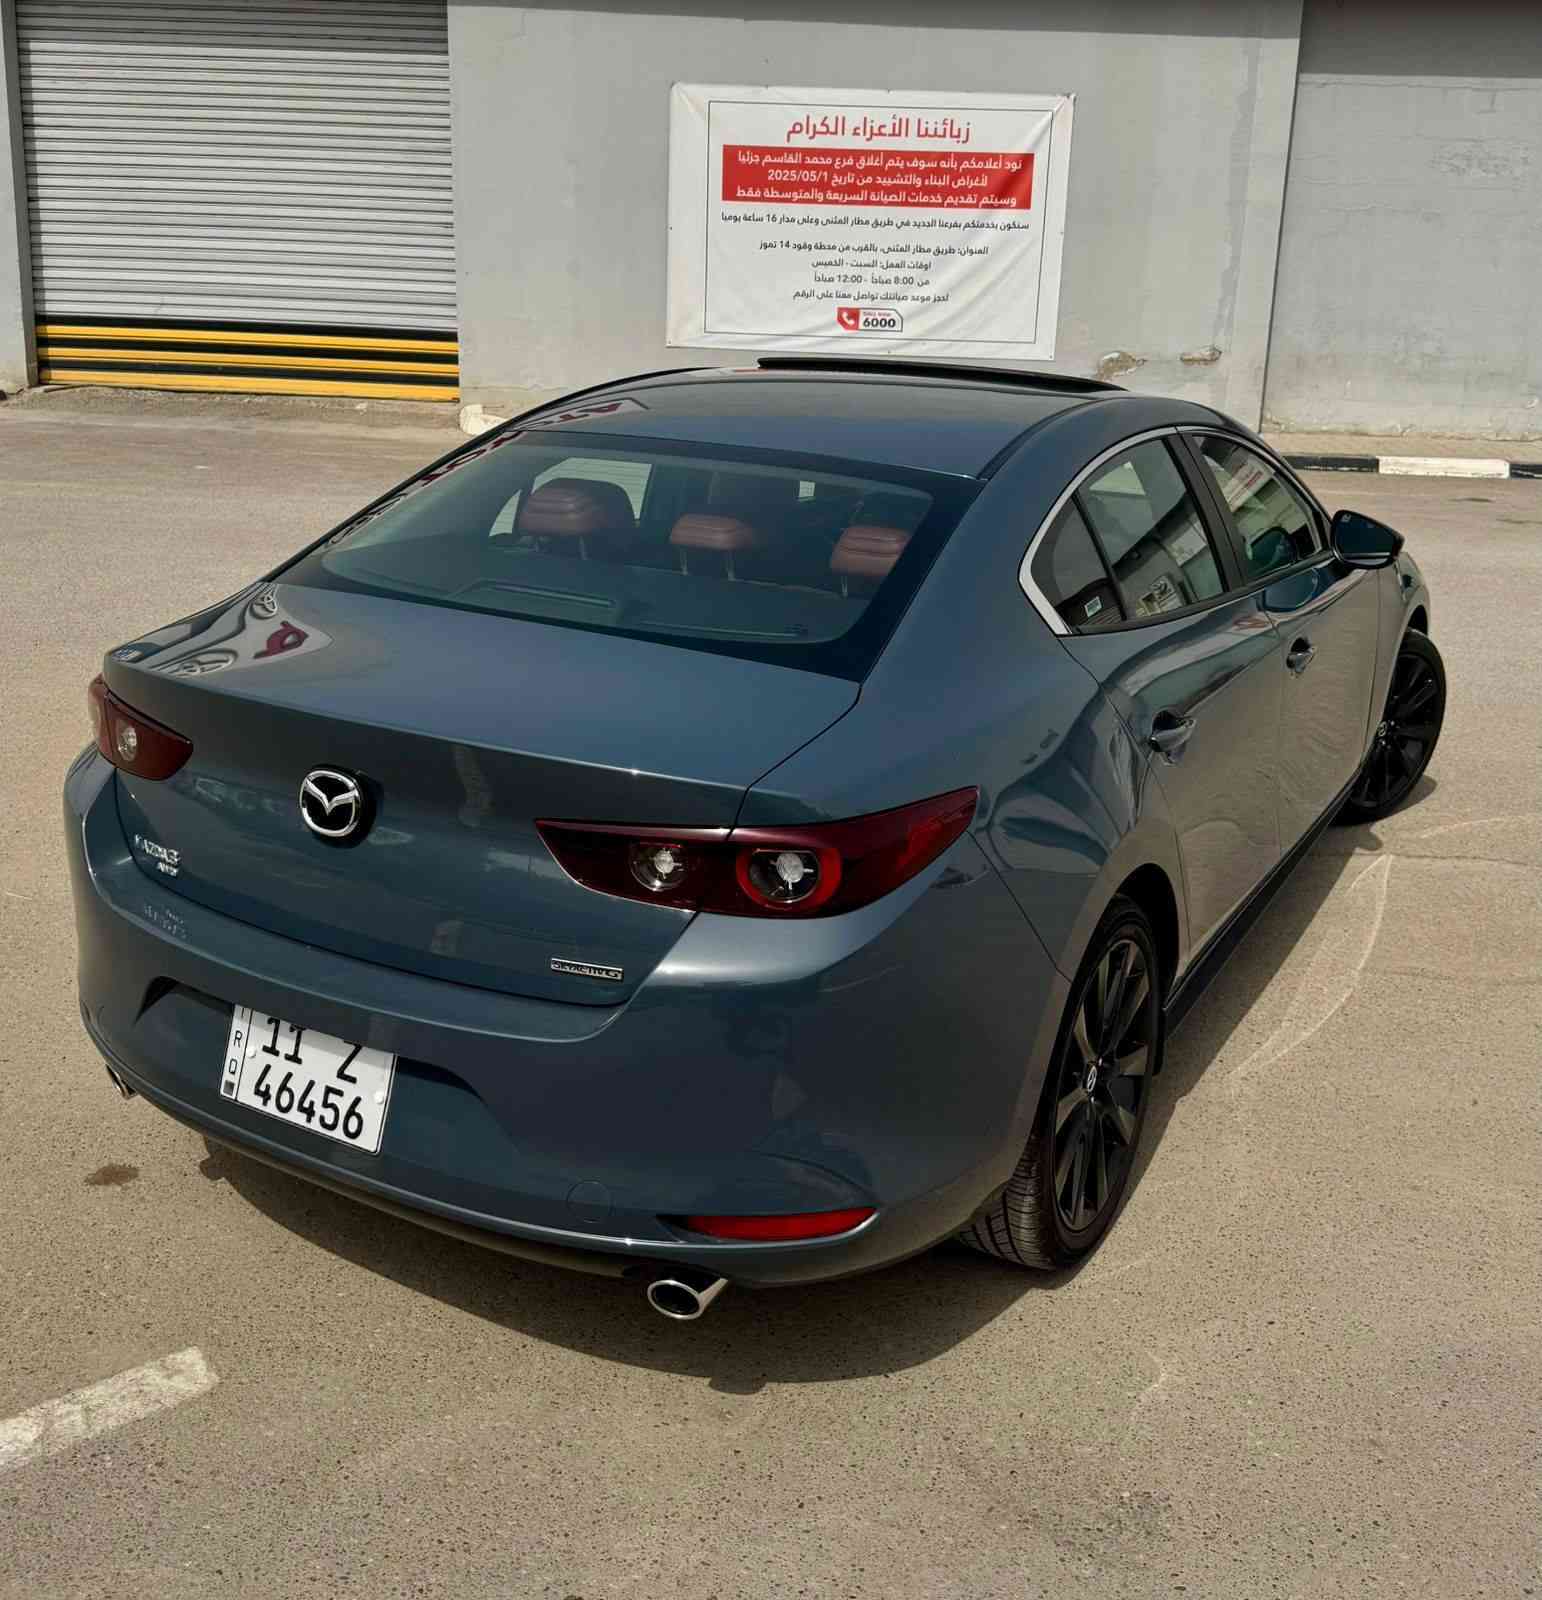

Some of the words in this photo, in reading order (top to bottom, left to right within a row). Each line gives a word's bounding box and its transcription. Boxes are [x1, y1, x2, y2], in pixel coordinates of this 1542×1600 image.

[786, 114, 845, 144] الكرام
[852, 114, 909, 142] الأعزاء
[917, 117, 970, 144] زبائننا
[762, 152, 801, 167] القاسم
[804, 155, 832, 165] محمد
[834, 156, 854, 169] فرع
[885, 156, 904, 170] يتم
[907, 158, 938, 170] سوف
[1004, 160, 1022, 172] نود
[768, 169, 828, 182] 2025/05/1
[832, 172, 854, 186] تاريخ
[856, 176, 872, 184] من
[876, 174, 922, 188] والتشييد
[924, 175, 950, 186] البناء
[736, 186, 761, 198] فقط
[763, 188, 824, 202] والمتوسطة
[826, 190, 868, 202] السريعة
[870, 190, 906, 202] الصيانة
[909, 192, 942, 204] خدمات
[944, 194, 976, 207] تقديم
[979, 194, 1016, 208] وسيتم
[743, 212, 763, 222] ساعة
[767, 214, 777, 222] 16
[780, 214, 796, 224] مدار
[850, 216, 870, 227] مطار
[871, 216, 893, 228] طريق
[912, 218, 936, 228] الجديد
[896, 220, 910, 228] في
[780, 240, 791, 248] 14
[814, 242, 836, 250] محطة
[912, 244, 931, 255] مطار
[932, 245, 956, 256] طريق
[837, 274, 862, 283] 12:00
[894, 276, 914, 285] 8:00
[793, 290, 814, 300] الرقم
[864, 318, 896, 328] 6000
[262, 1016, 306, 1065] 11
[253, 1063, 364, 1140] 46456
